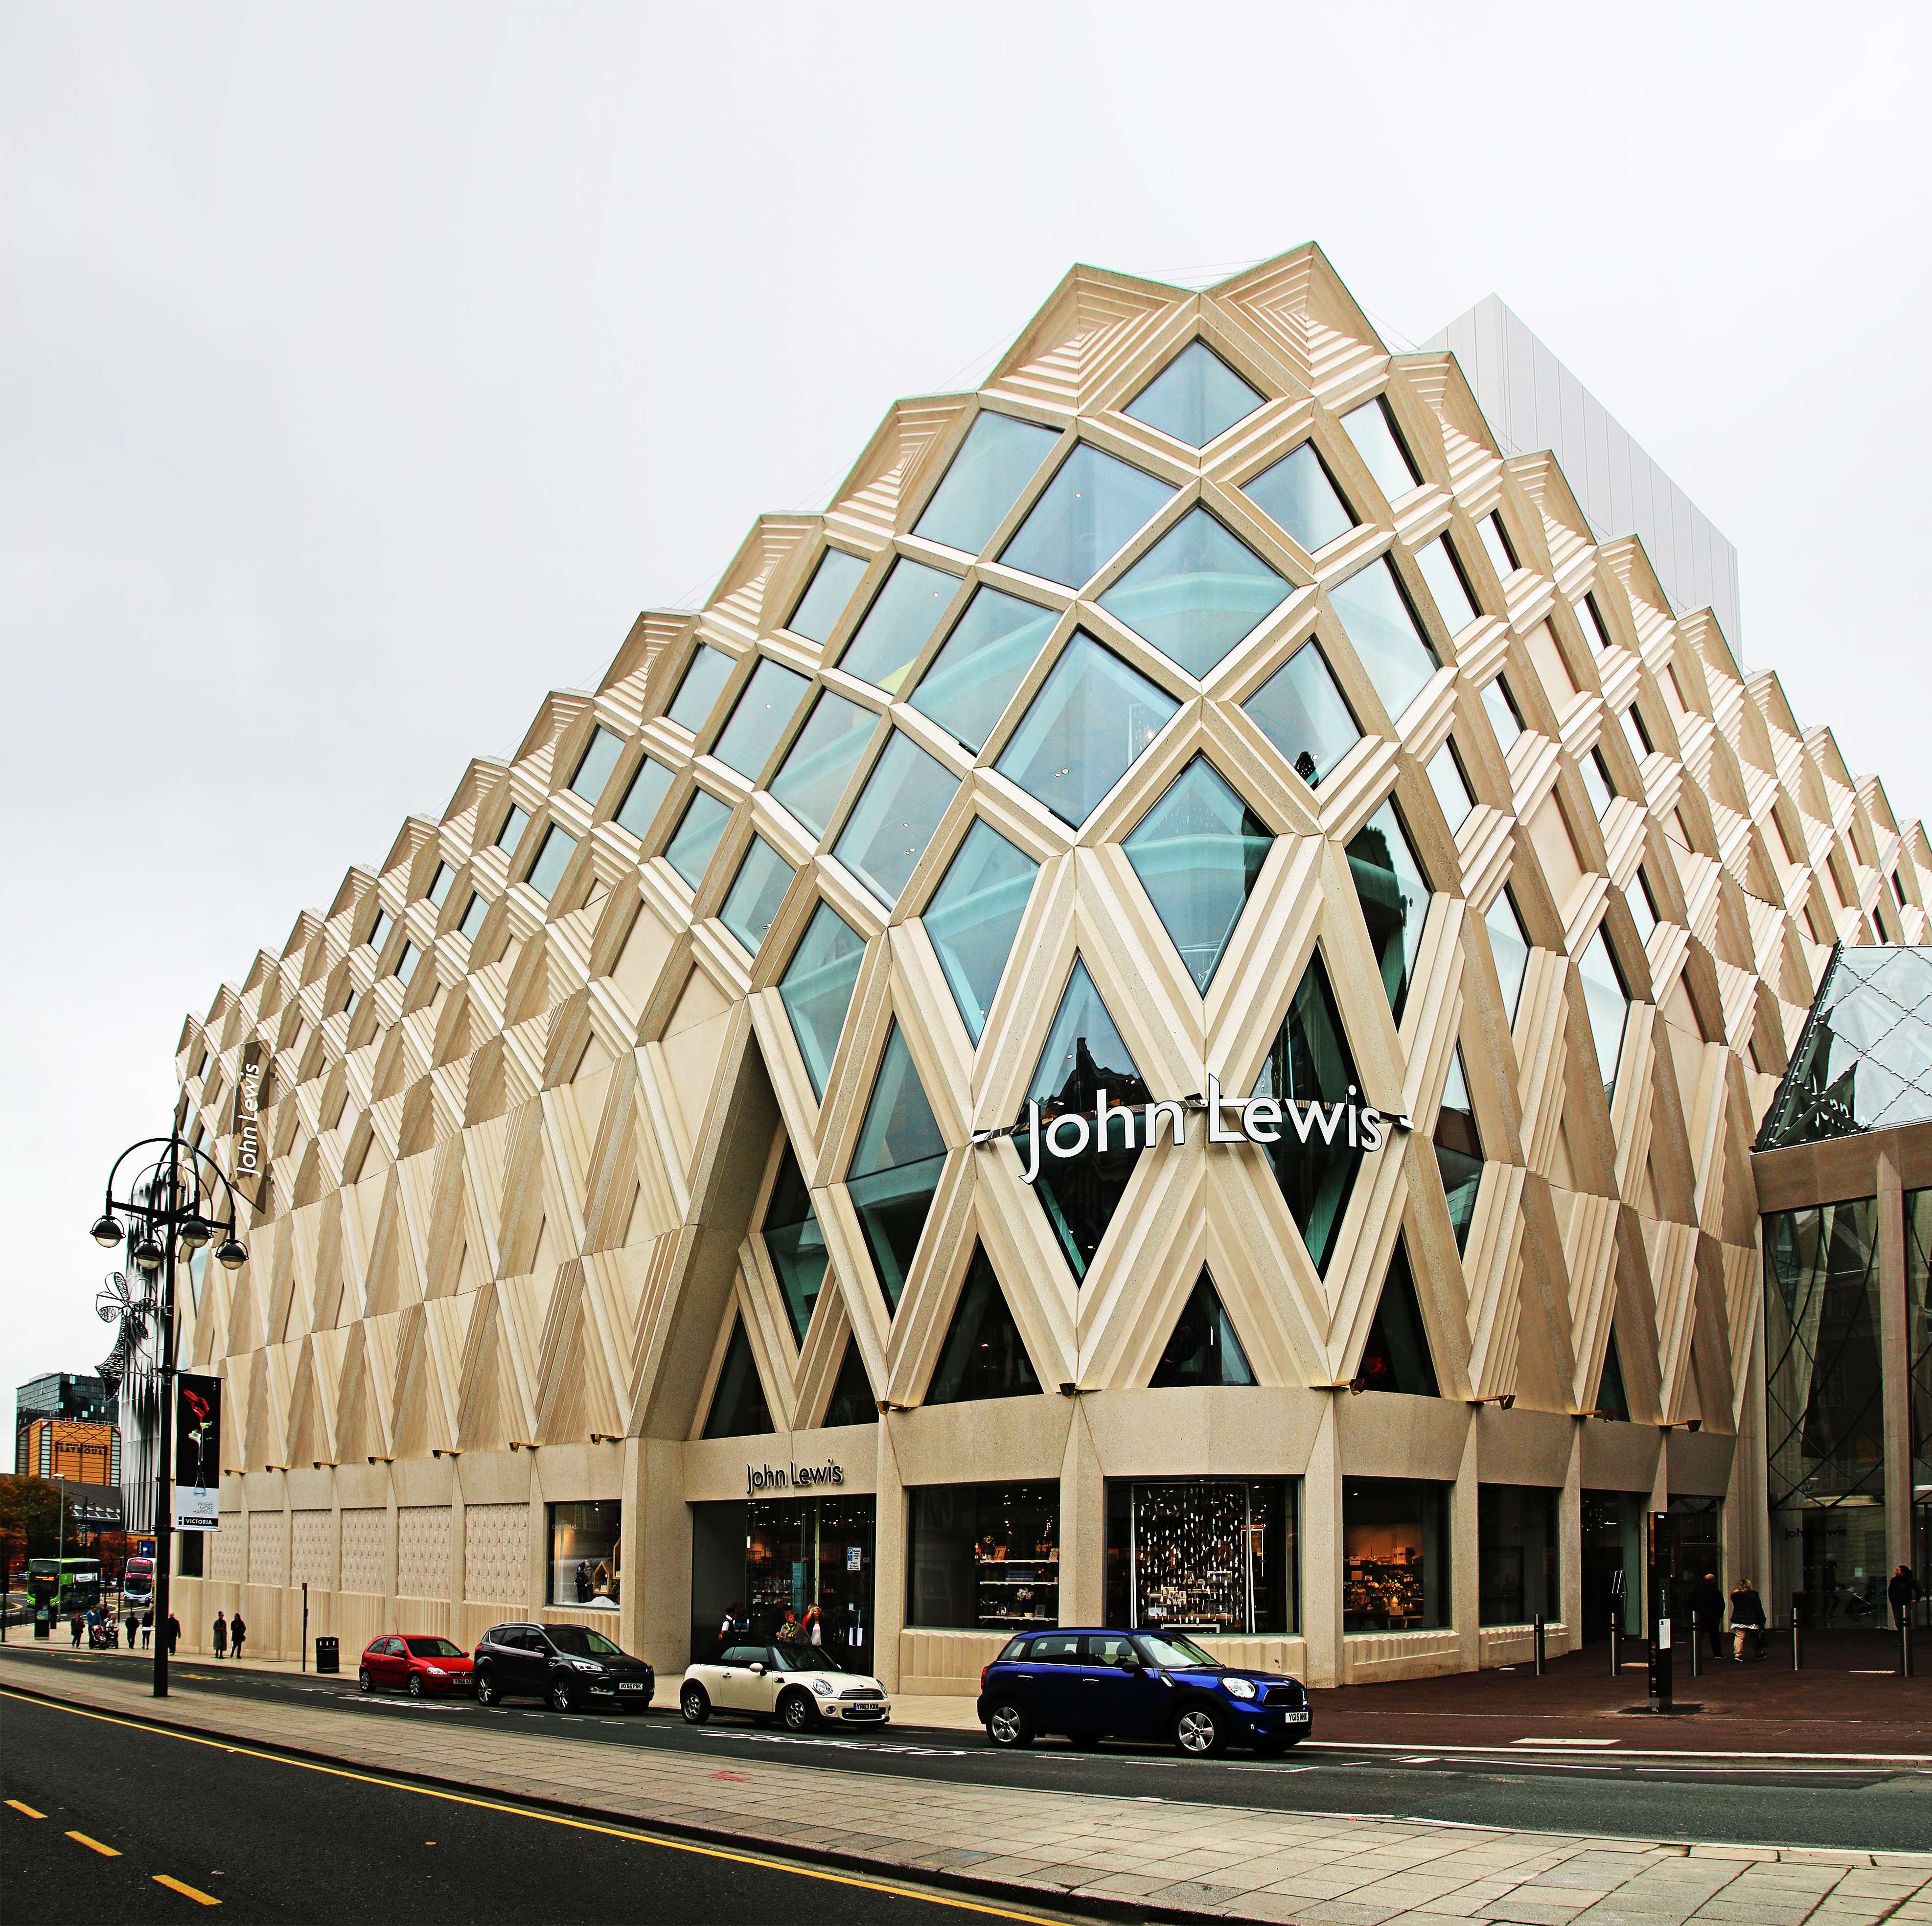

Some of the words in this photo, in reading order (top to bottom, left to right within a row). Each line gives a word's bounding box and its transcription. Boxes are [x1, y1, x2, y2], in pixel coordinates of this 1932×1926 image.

[237, 1063, 260, 1122] Lewis
[235, 1125, 262, 1178] John
[1018, 1088, 1186, 1185] John
[1208, 1073, 1383, 1153] Lewis
[746, 1463, 787, 1495] John
[790, 1458, 843, 1485] Lewis
[1288, 1713, 1300, 1721] YG15
[700, 1733, 967, 1756] DISABLED
